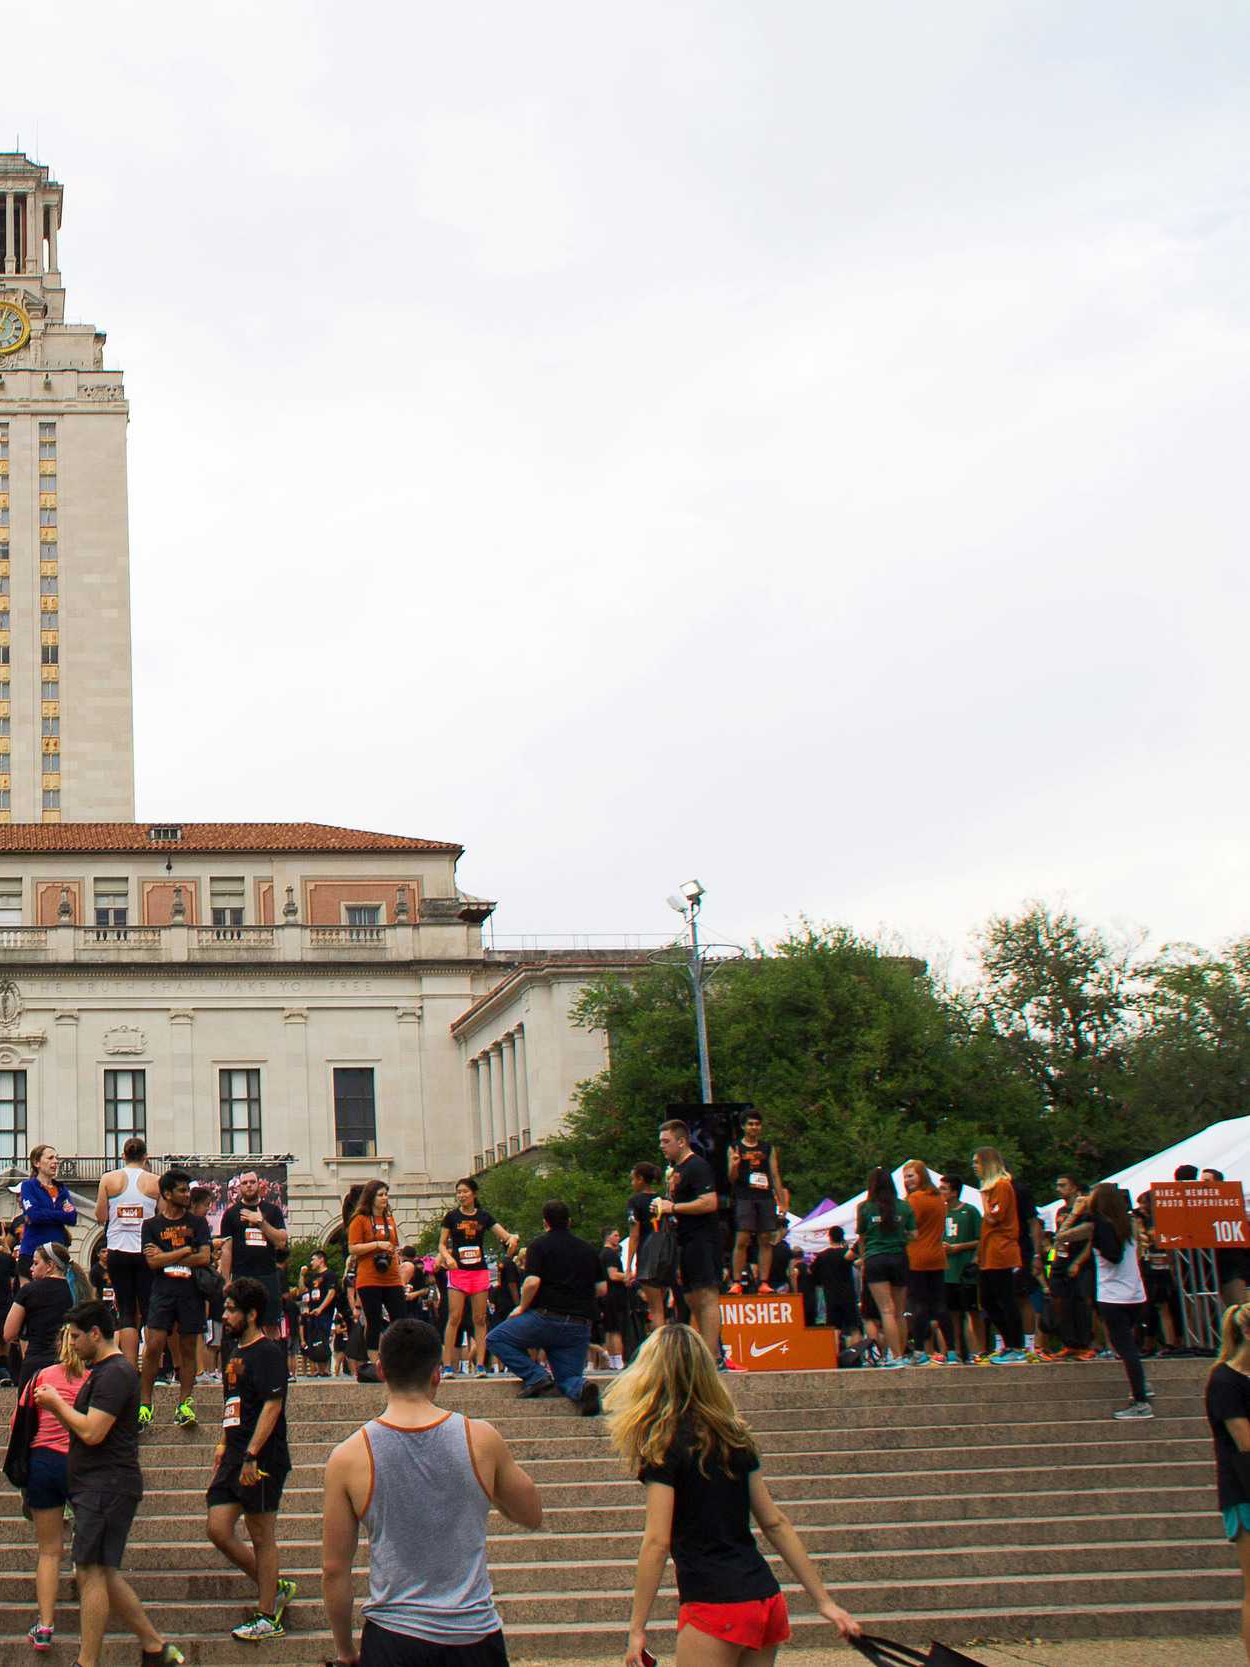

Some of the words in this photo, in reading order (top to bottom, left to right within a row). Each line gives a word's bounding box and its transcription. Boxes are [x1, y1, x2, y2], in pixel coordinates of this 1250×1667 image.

[29, 983, 63, 992] THE
[76, 982, 135, 992] TRUTH
[149, 982, 206, 992] SHALL
[220, 982, 267, 992] MAKE
[328, 981, 372, 992] FREE
[1184, 1188, 1220, 1197] MEMBER
[1156, 1199, 1183, 1207] PHOTO
[1186, 1198, 1240, 1207] EXPERIENCE
[1212, 1220, 1246, 1242] 10K
[719, 1303, 793, 1325] INISHER
